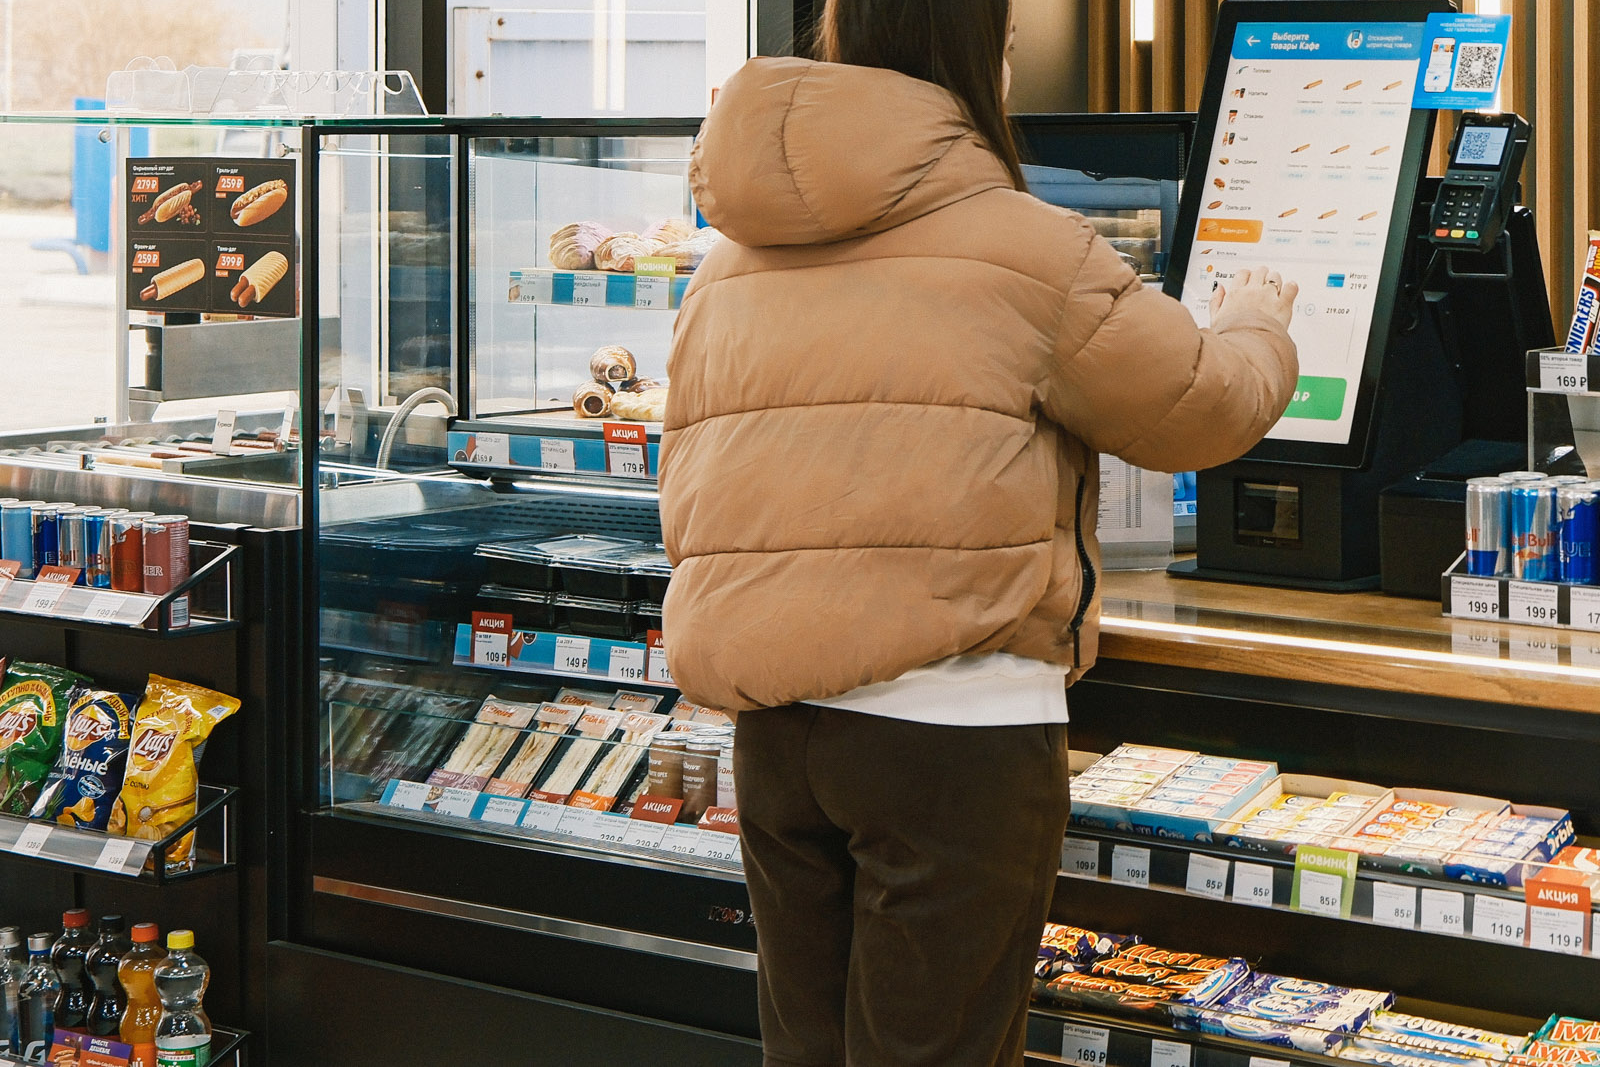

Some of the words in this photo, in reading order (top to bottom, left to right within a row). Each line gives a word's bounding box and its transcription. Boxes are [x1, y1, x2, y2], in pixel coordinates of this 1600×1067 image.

[1272, 32, 1310, 41] Выберите
[1271, 42, 1297, 50] товары
[1299, 42, 1320, 51] Кафе
[137, 179, 150, 189] 279
[132, 195, 147, 203] ХИТ!
[638, 263, 673, 272] НОВИНКА
[1557, 375, 1577, 388] 169
[612, 429, 639, 439] АКЦИЯ
[622, 463, 637, 473] 179
[1468, 600, 1489, 613] 199
[479, 617, 505, 629] АКЦИЯ
[486, 651, 500, 662] 109
[566, 657, 581, 668] 149
[642, 802, 672, 812] АКЦИЯ
[1206, 879, 1216, 889] 85
[1537, 889, 1578, 903] АКЦИЯ
[1491, 923, 1512, 938] 119
[1398, 1014, 1479, 1038] BOUNTY
